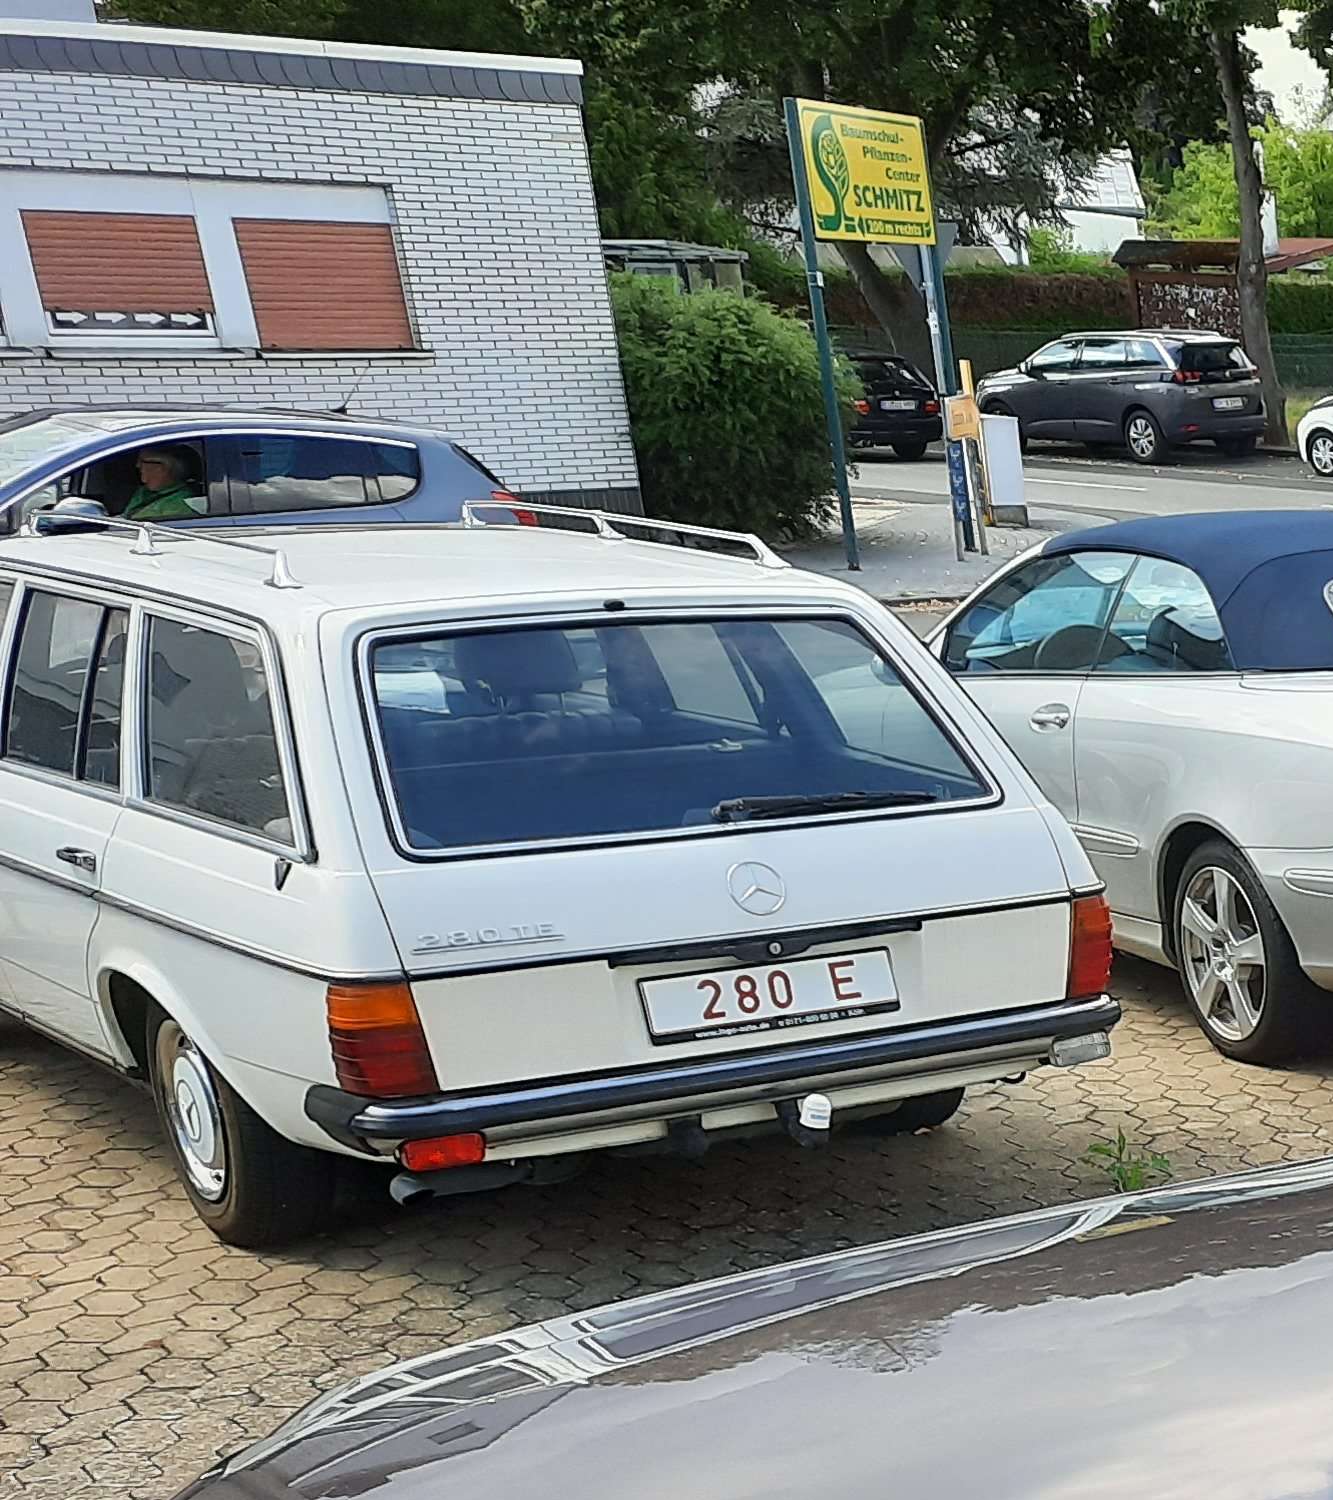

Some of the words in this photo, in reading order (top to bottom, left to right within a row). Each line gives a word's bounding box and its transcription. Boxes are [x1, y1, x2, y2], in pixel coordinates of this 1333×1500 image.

[885, 167, 921, 182] Center
[853, 184, 925, 212] SCHMITZ
[417, 927, 499, 948] 280
[510, 922, 554, 939] TE
[697, 970, 793, 1020] 280
[826, 959, 863, 1001] E
